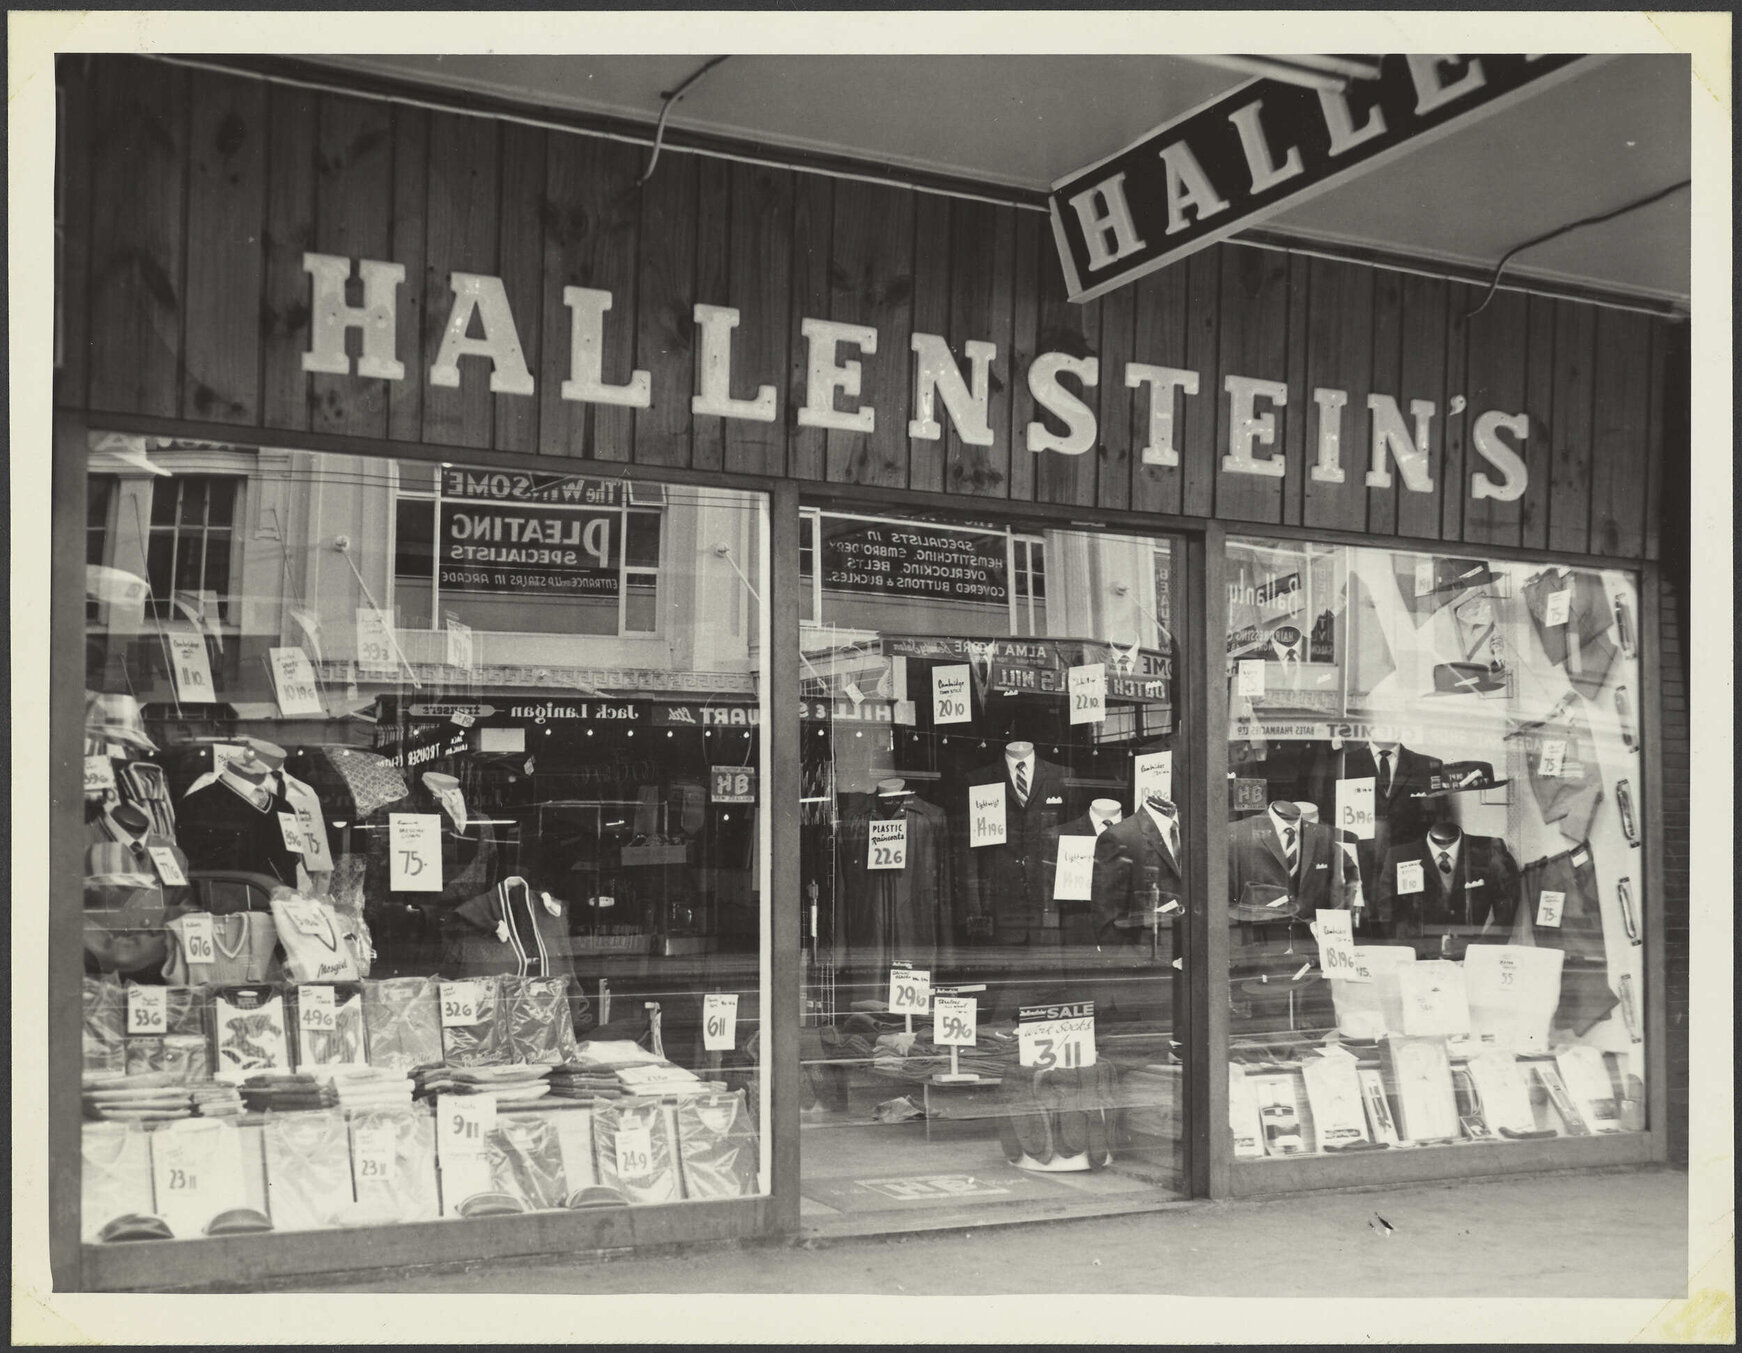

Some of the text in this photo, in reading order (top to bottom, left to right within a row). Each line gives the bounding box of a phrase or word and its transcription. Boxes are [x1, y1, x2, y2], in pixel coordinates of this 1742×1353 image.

[1068, 54, 1546, 271] HALLE
[302, 252, 1530, 502] HALLENSTEIN'S
[938, 699, 953, 717] 20
[872, 824, 903, 834] PLASTIC
[1046, 1003, 1094, 1019] SALE
